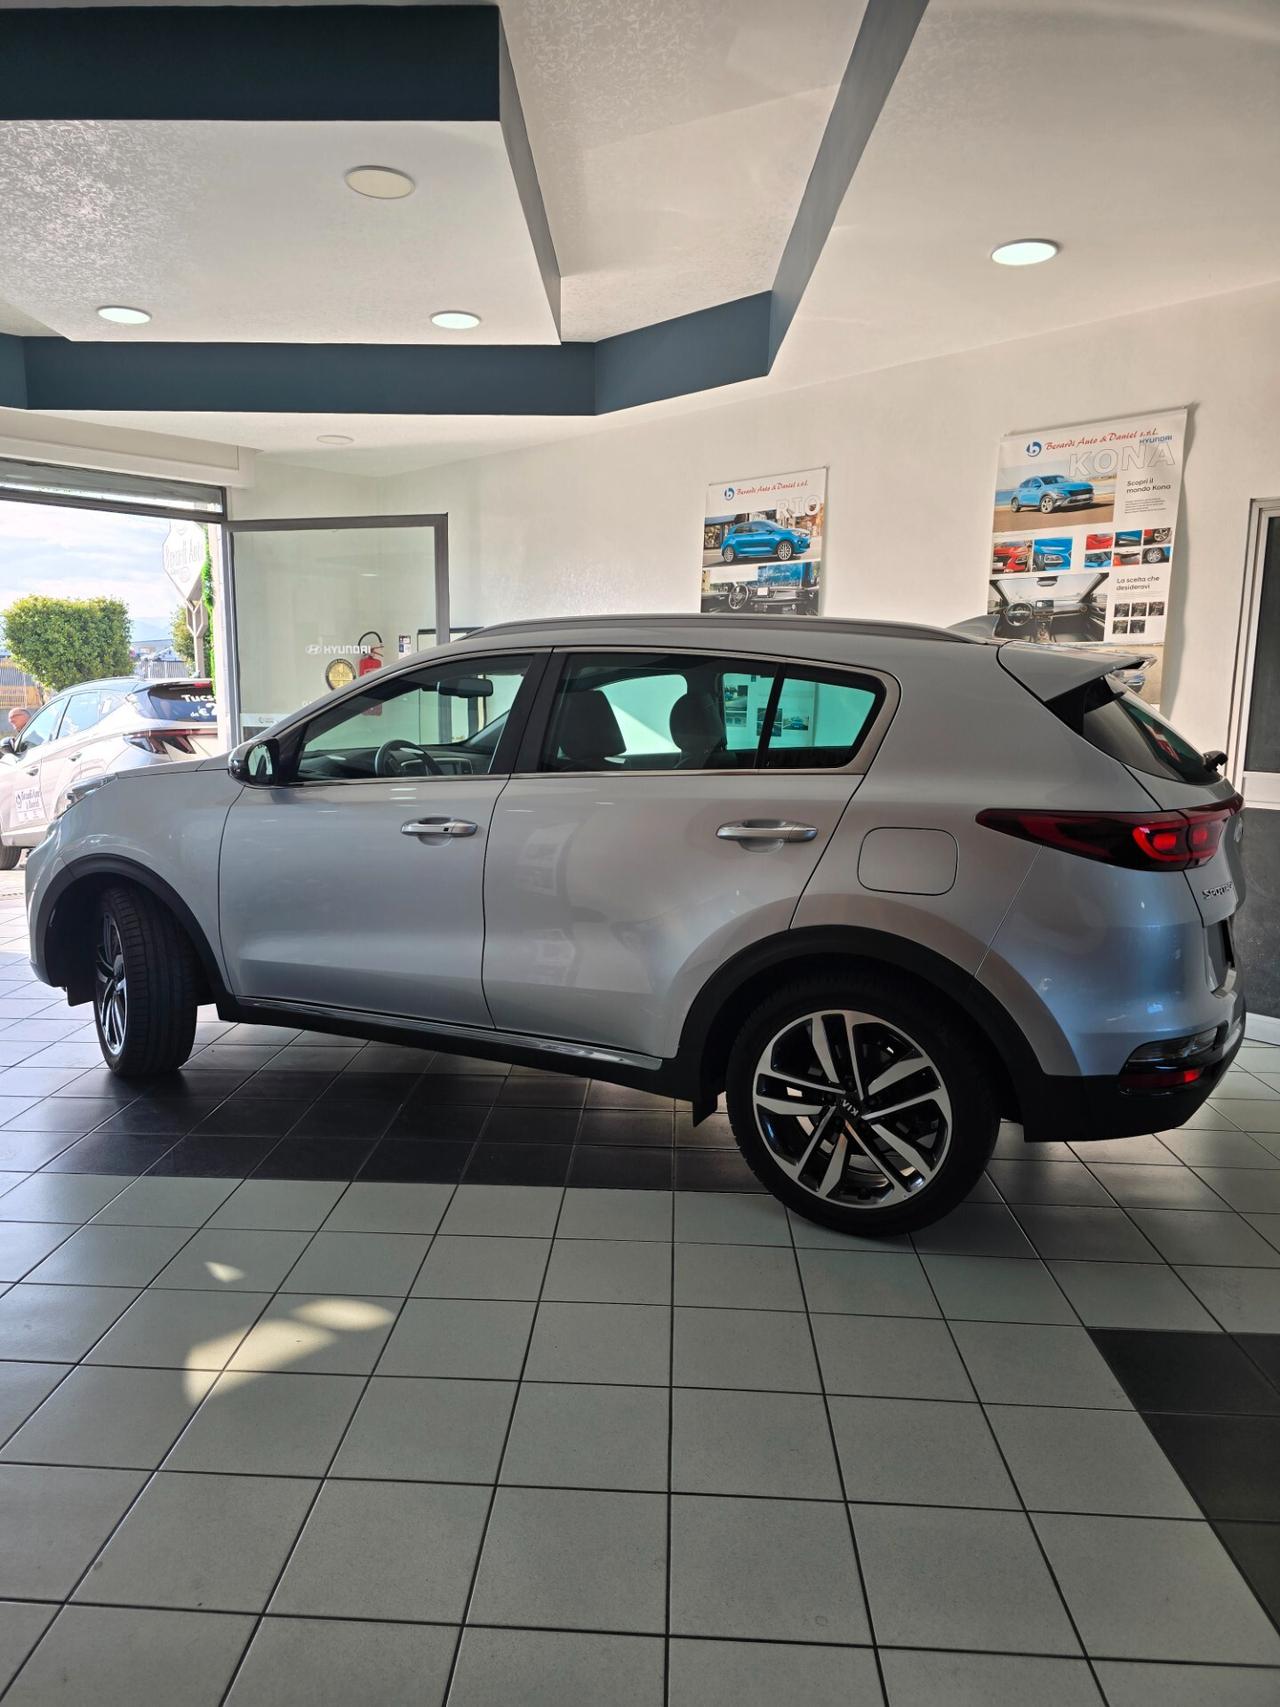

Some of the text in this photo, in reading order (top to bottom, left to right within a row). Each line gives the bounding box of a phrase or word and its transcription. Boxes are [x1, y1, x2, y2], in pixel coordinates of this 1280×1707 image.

[1077, 437, 1098, 448] Auto
[1099, 435, 1107, 443] &
[1107, 430, 1138, 441] Daniel
[1139, 434, 1173, 444] HYUNDAI
[1069, 441, 1176, 479] KONA
[1127, 478, 1149, 488] Scopri
[1126, 486, 1151, 494] mondo
[776, 494, 821, 521] RIO
[1116, 583, 1151, 591] desideravi
[324, 645, 371, 654] HYUNDAI
[180, 694, 217, 703] Tucs
[842, 1099, 859, 1117] KIA
